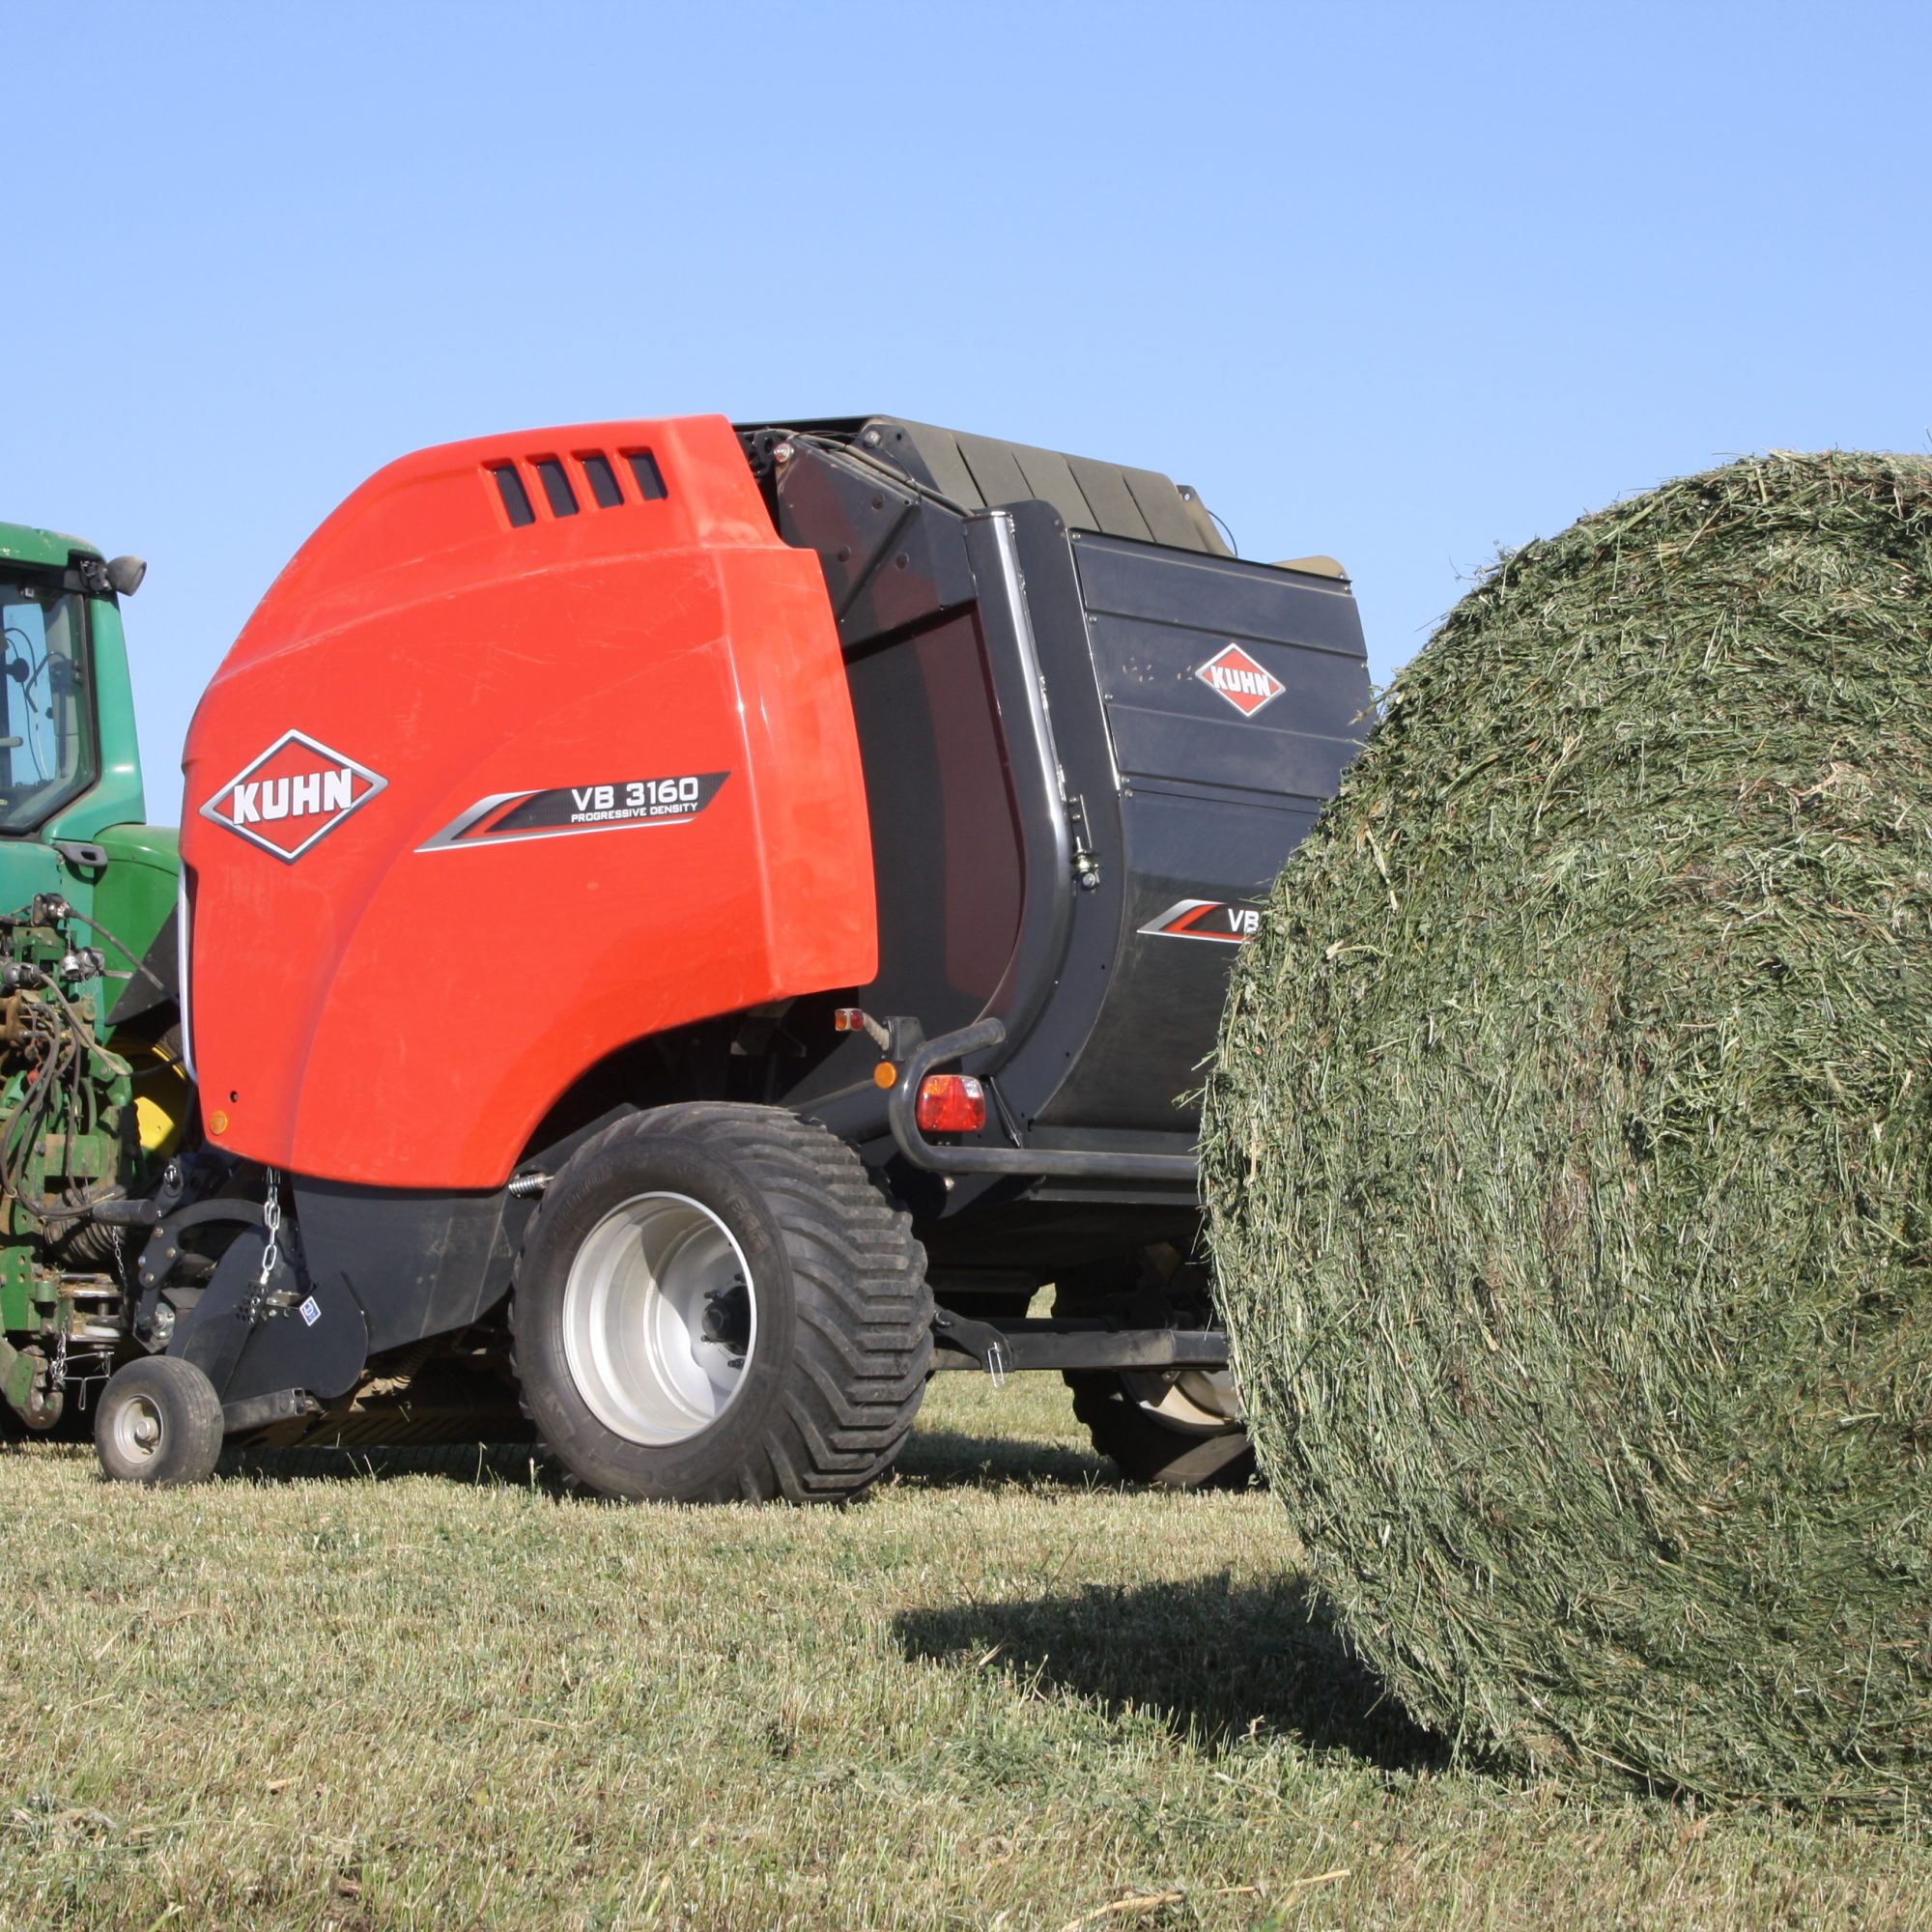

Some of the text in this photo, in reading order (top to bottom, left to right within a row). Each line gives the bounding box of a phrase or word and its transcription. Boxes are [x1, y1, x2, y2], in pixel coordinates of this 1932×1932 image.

[1210, 665, 1271, 697] KUHN
[233, 768, 352, 825] KUHN
[571, 777, 698, 811] VB 3160
[571, 803, 698, 823] PROGRESSIVE DENSITY
[1228, 908, 1260, 933] VB
